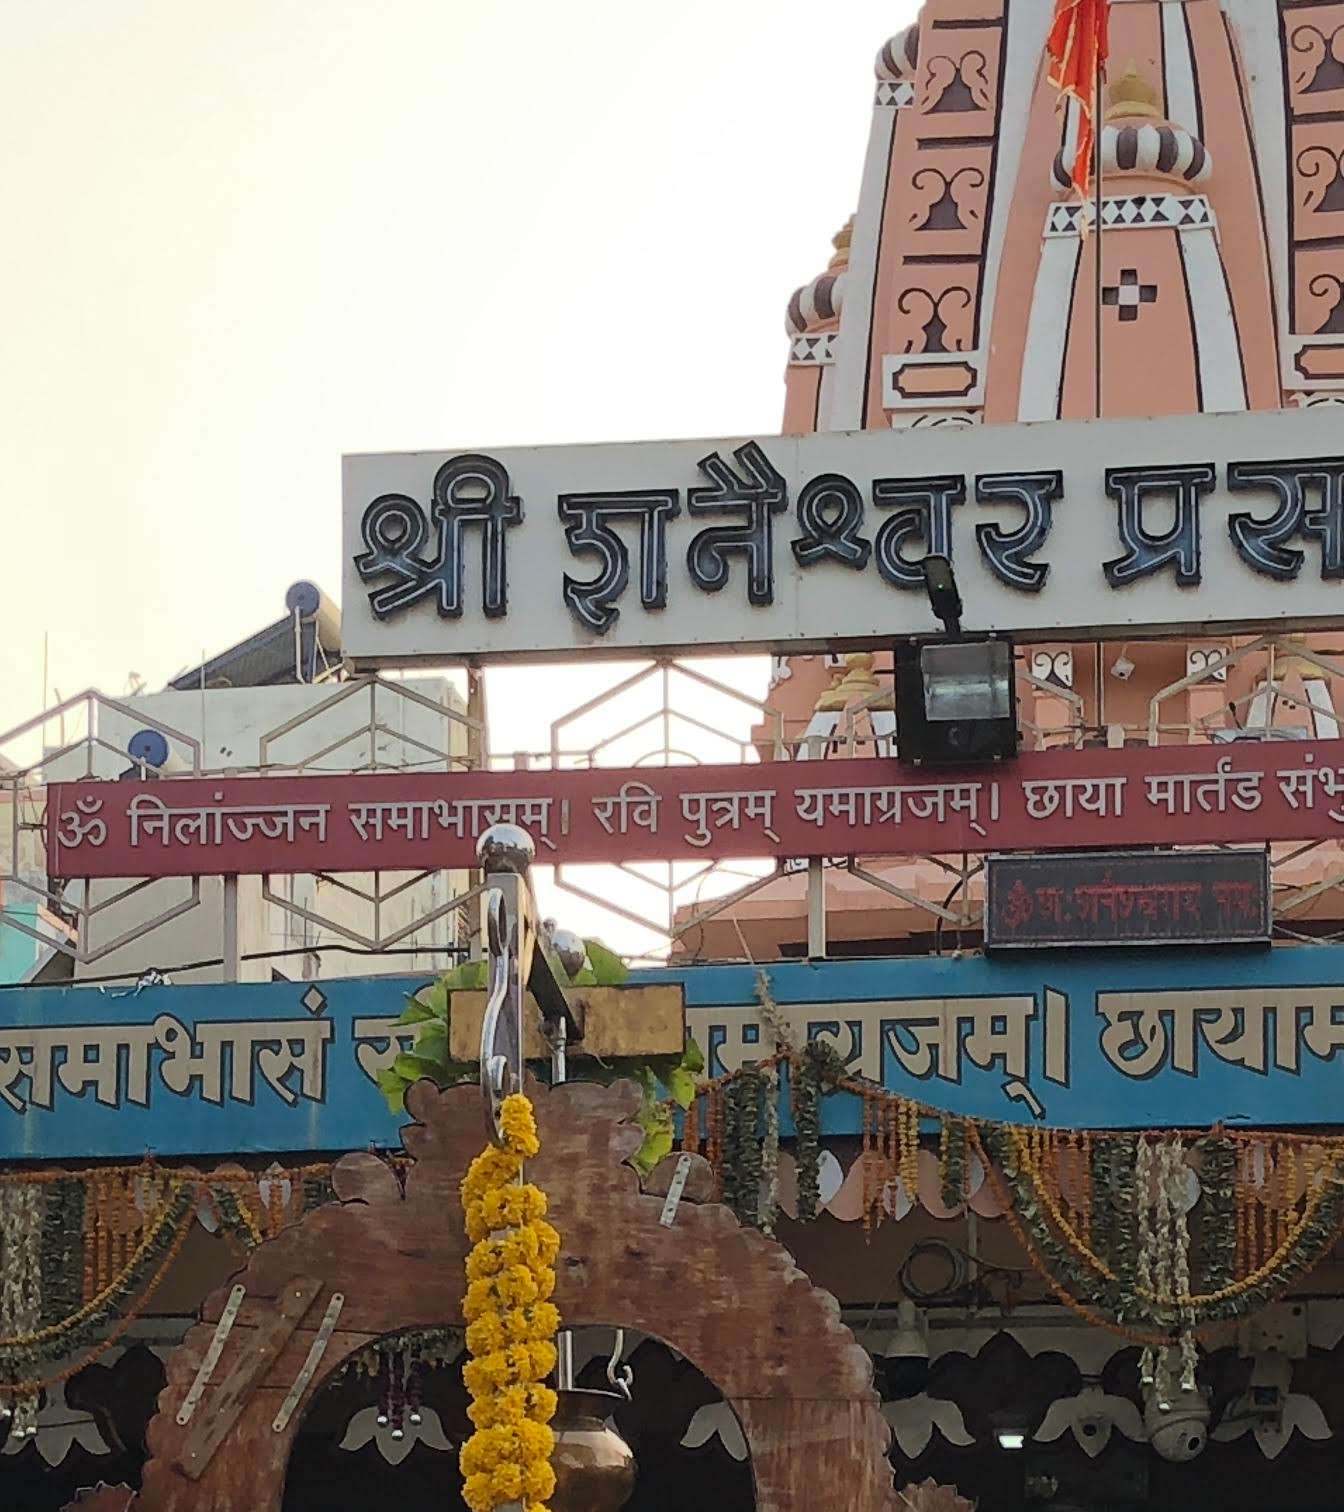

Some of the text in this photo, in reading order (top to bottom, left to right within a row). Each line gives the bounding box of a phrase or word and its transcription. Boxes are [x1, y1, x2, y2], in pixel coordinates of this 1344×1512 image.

[352, 453, 525, 622] श्री
[557, 440, 1064, 635] शनैश्वर
[58, 795, 108, 849] ॐ
[592, 781, 661, 838] रवि
[678, 789, 781, 848] पुत्रम्
[1021, 776, 1128, 819] छाया
